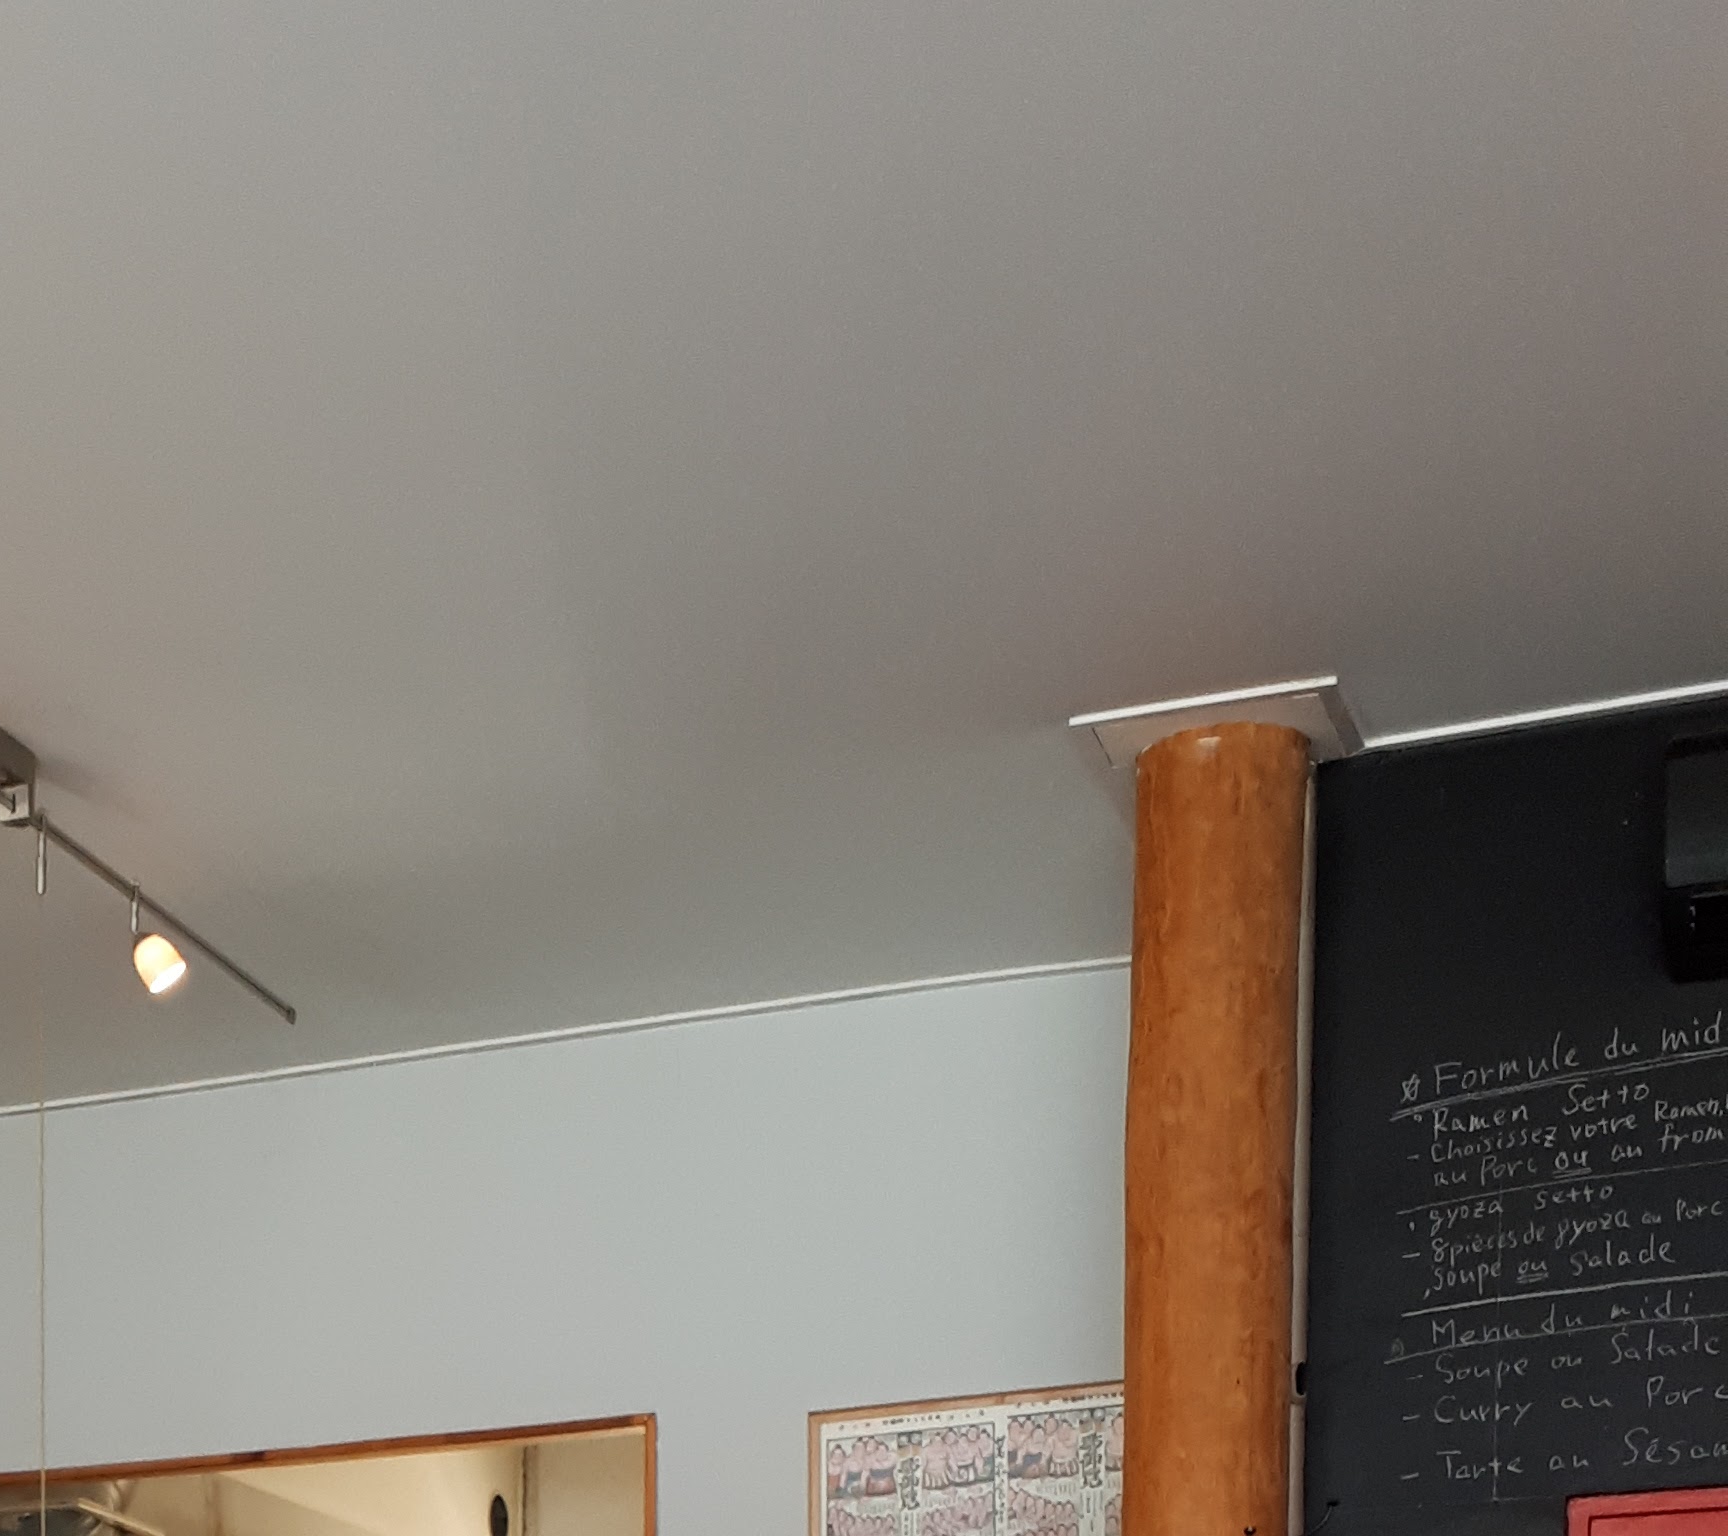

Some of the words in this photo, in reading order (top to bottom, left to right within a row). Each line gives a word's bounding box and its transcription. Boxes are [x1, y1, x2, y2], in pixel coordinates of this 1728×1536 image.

[1434, 1031, 1580, 1095] Formule
[1604, 1026, 1638, 1059] du
[1430, 1127, 1558, 1164] Choisissez
[1571, 1114, 1638, 1141] votre
[1433, 1105, 1528, 1141] Ramen
[1432, 1317, 1523, 1347] Menu
[1433, 1395, 1533, 1426] Curry
[1435, 1450, 1524, 1480] Tarte
